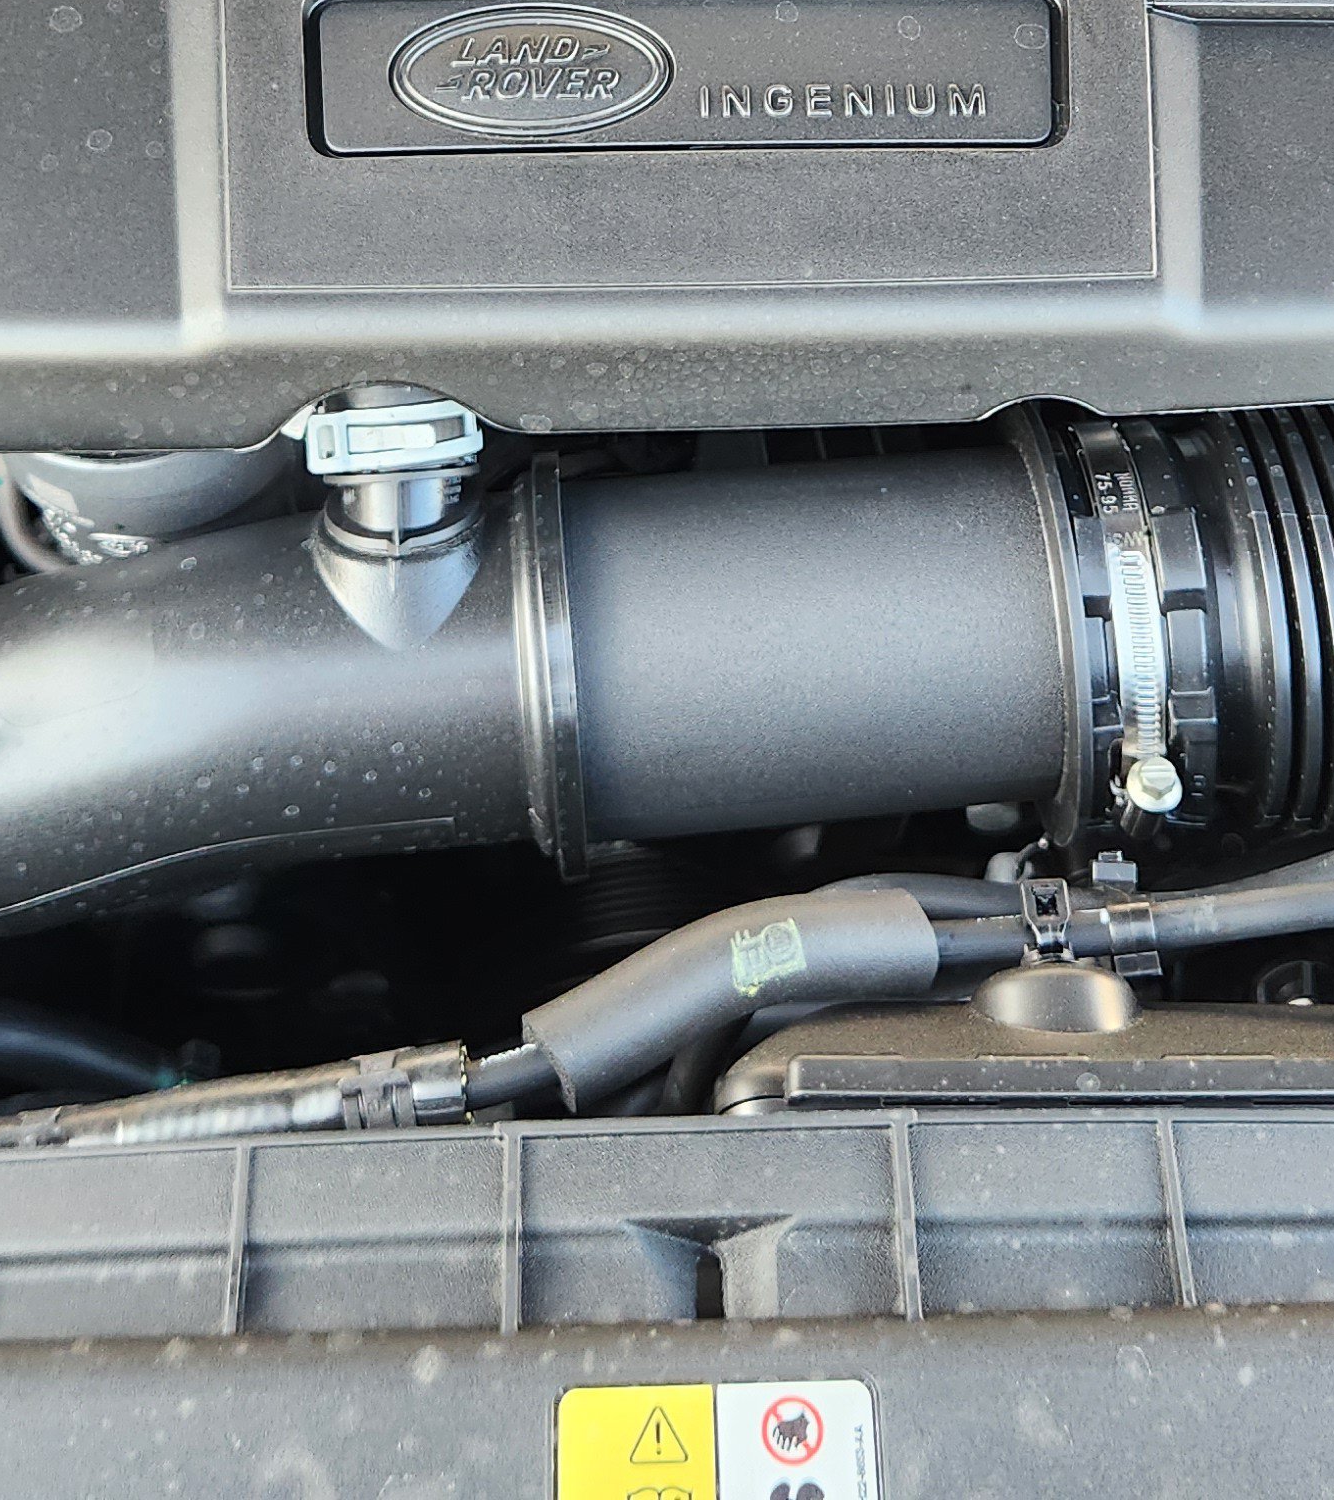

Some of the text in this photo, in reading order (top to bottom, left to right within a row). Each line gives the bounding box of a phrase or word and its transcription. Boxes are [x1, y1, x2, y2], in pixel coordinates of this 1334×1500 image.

[452, 37, 580, 67] LAND
[465, 67, 620, 100] ROVER
[698, 83, 989, 118] INGENIUM
